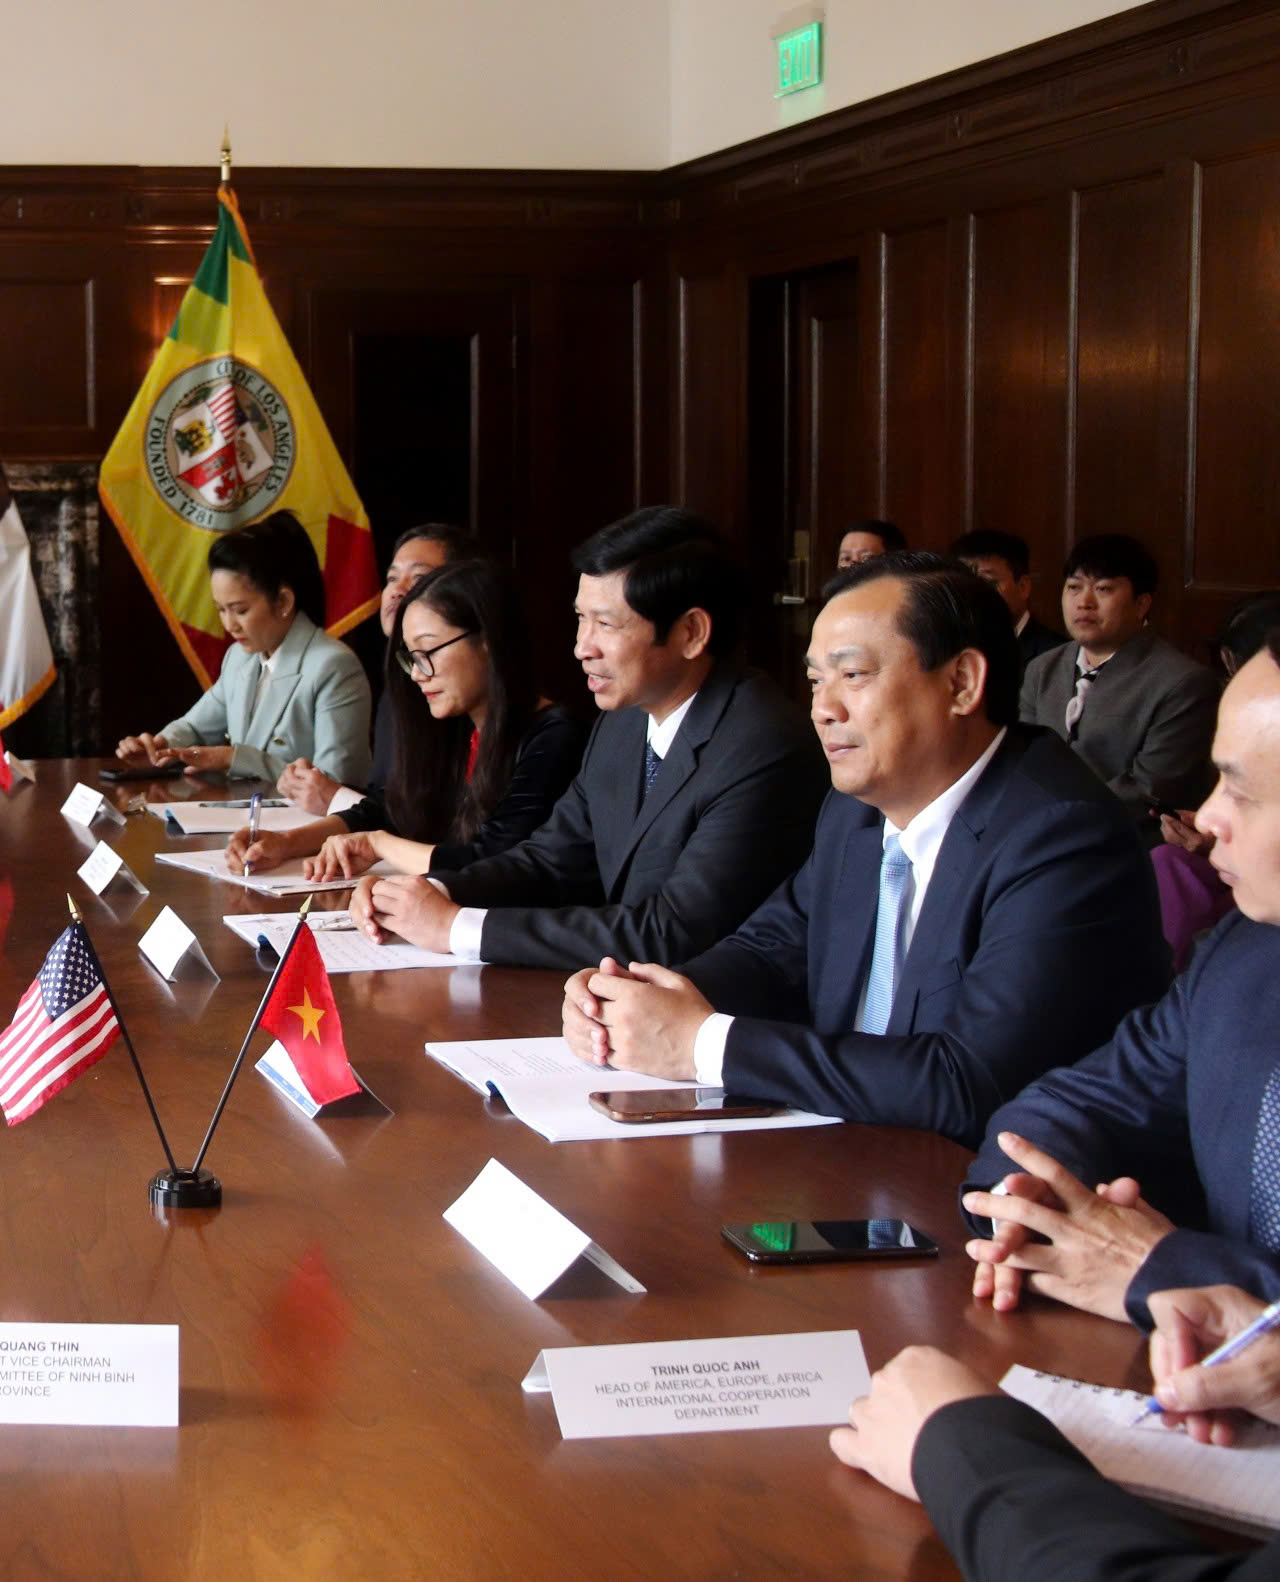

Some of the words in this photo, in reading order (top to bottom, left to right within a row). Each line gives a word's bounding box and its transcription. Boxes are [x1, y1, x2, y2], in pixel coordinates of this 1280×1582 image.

[779, 30, 812, 89] EXIT
[149, 416, 177, 499] FOUNDED
[179, 502, 213, 525] 1781
[0, 1341, 46, 1353] QUANG
[51, 1341, 80, 1352] THIN
[10, 1355, 38, 1367] VICE
[43, 1355, 111, 1368] CHAIRMAN
[651, 1365, 689, 1376] TRINH
[694, 1363, 731, 1374] QUOC
[734, 1360, 760, 1371] ANH
[48, 1371, 66, 1383] OF
[70, 1372, 101, 1383] NINH
[104, 1372, 135, 1383] BINH
[595, 1383, 631, 1394] HEAD
[634, 1381, 651, 1392] OF
[777, 1372, 823, 1383] AFRICA
[616, 1394, 713, 1408] INTERNATIONAL
[719, 1387, 811, 1401] COOPERATION
[674, 1405, 761, 1420] DEPARTMENT
